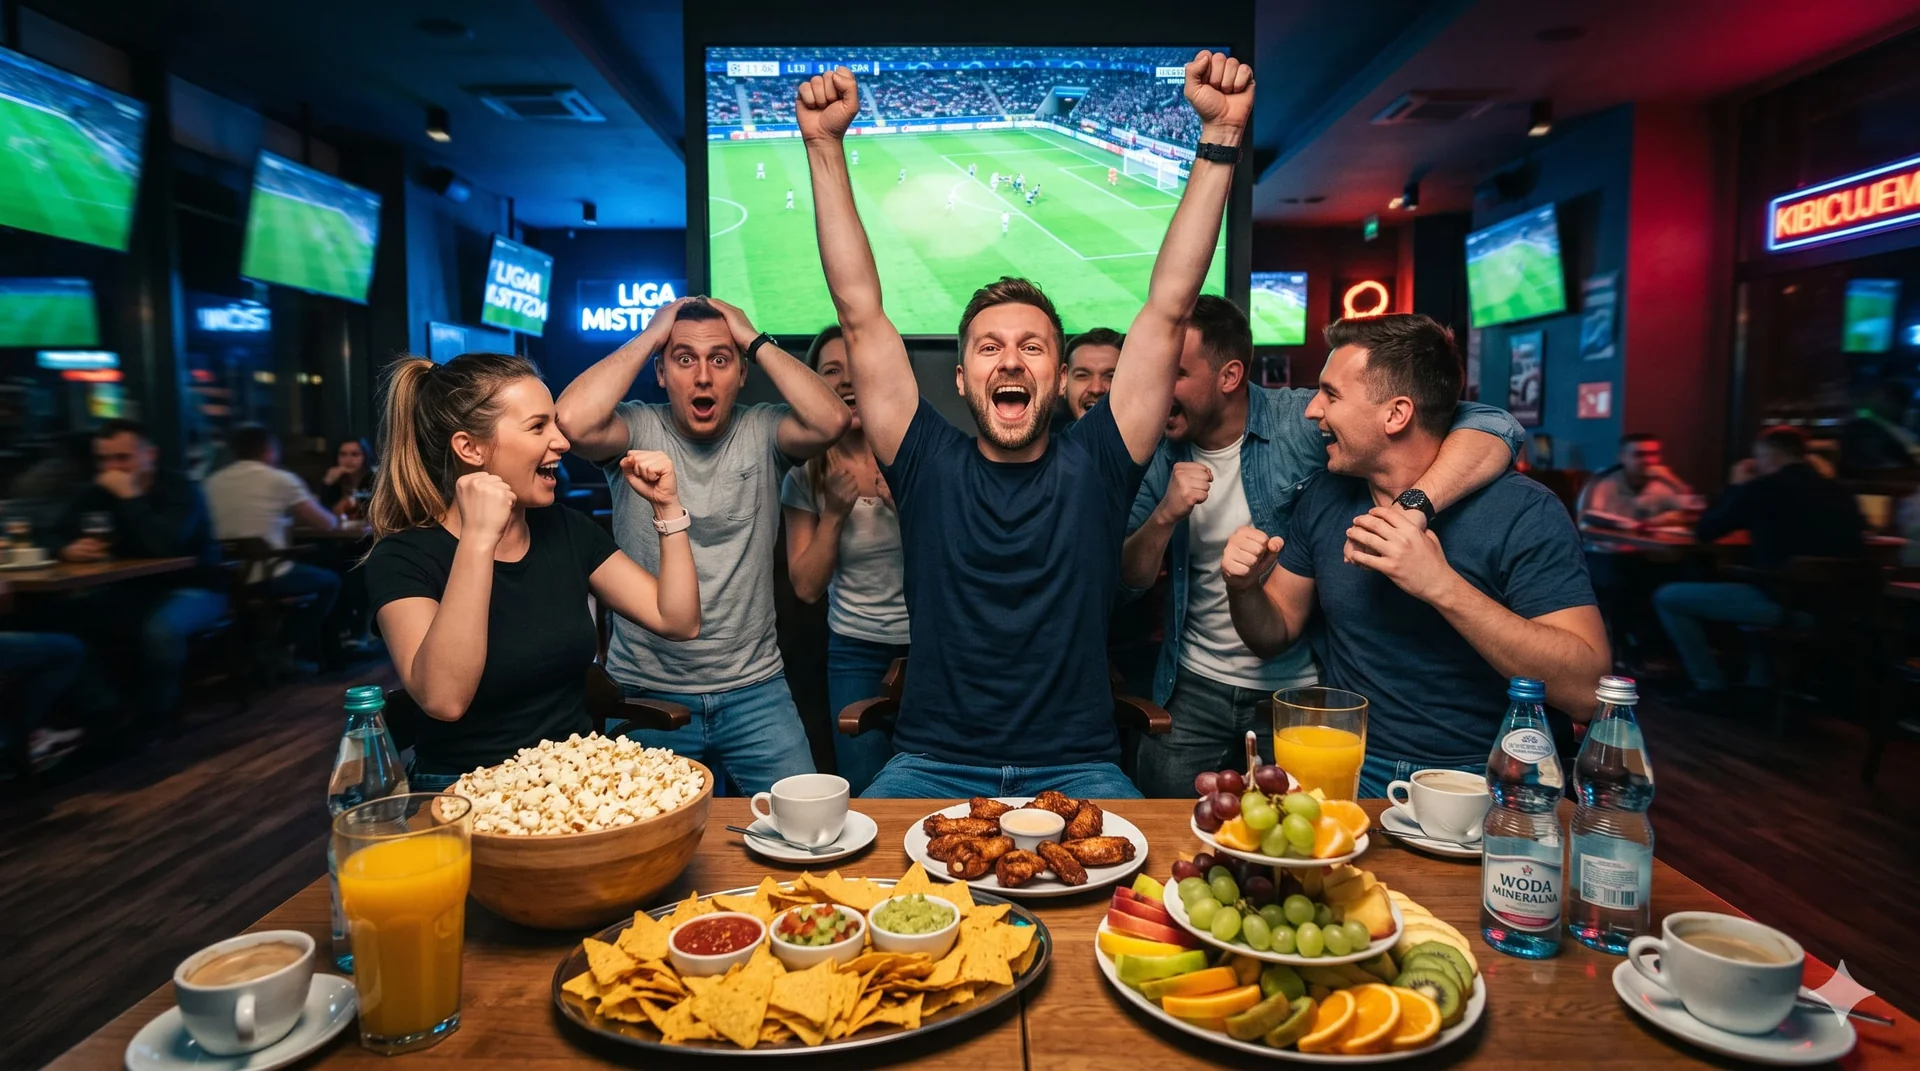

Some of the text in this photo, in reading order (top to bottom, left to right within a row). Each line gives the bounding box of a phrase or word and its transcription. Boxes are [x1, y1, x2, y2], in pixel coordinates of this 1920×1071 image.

[1775, 170, 1920, 239] KIBICUJEM
[618, 283, 676, 307] LIGA
[1492, 884, 1558, 904] MINERALNA
[1500, 873, 1552, 893] WODA
